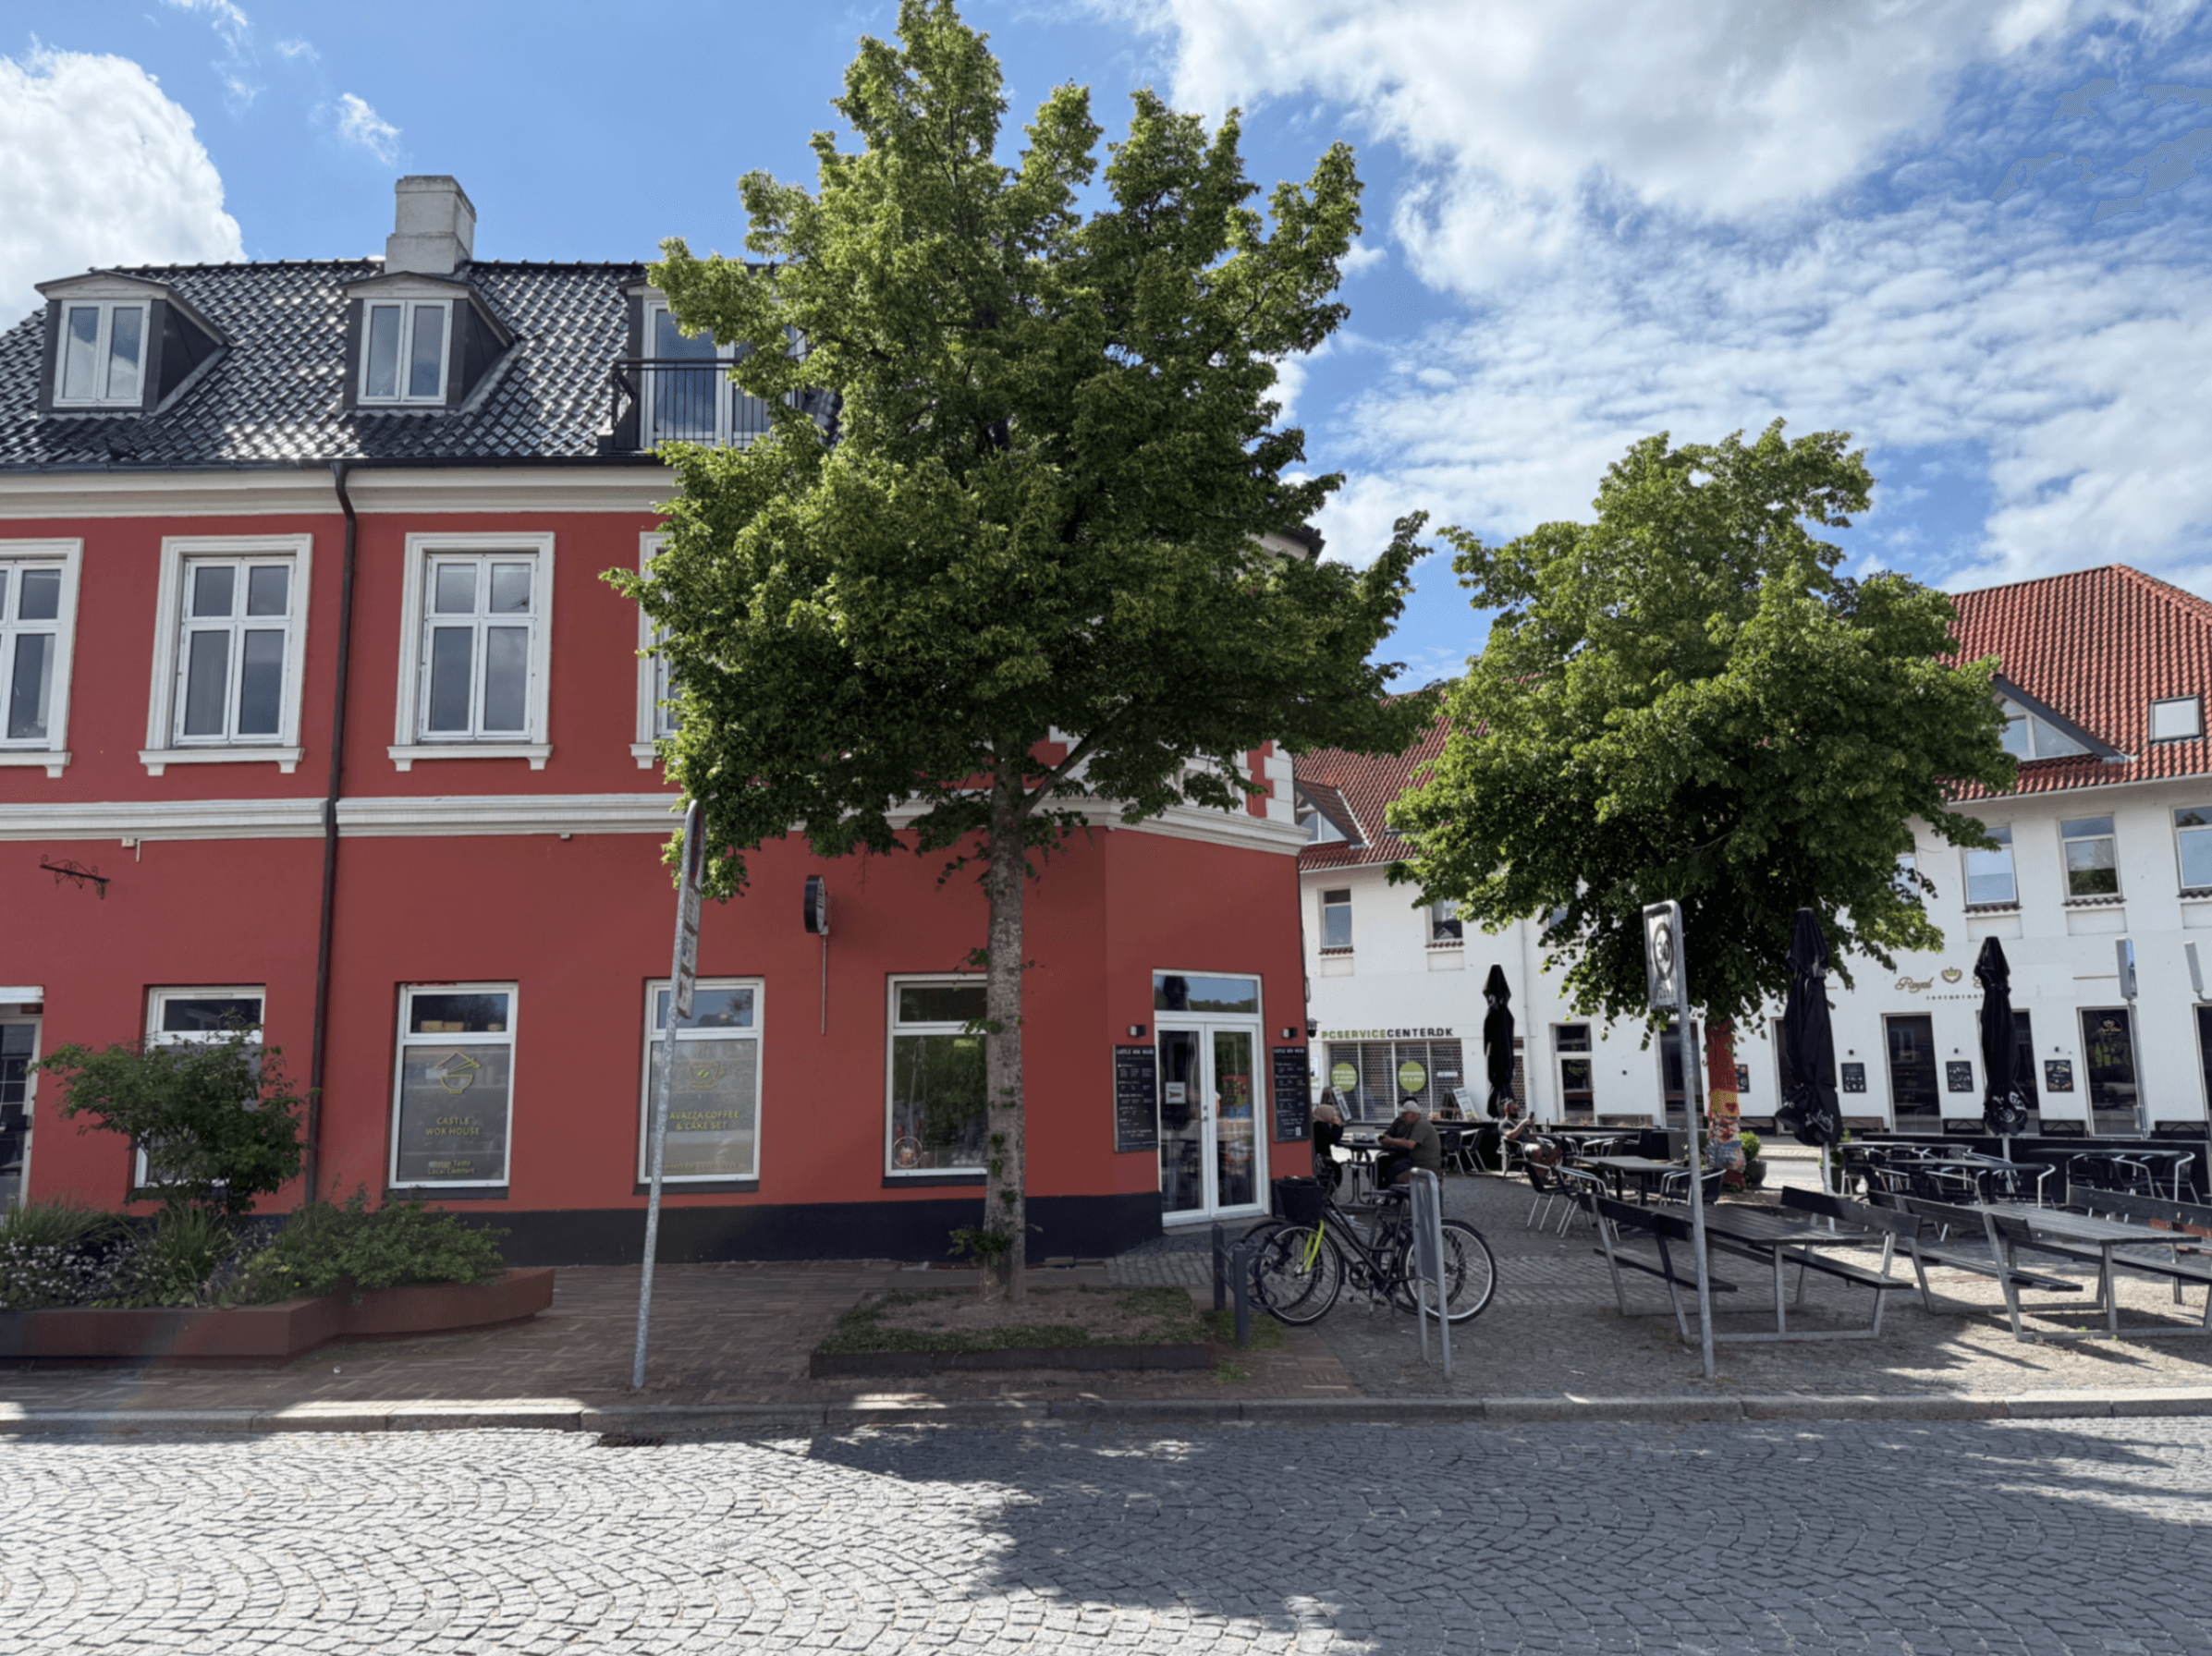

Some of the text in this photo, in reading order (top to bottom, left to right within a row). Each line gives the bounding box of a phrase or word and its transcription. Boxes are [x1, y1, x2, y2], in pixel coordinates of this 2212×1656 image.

[1656, 940, 1670, 962] 30
[1895, 976, 1934, 993] Royal
[705, 1110, 739, 1119] COFFEE
[436, 1116, 470, 1125] CASTLE
[448, 1126, 480, 1135] HOUSE
[676, 1121, 728, 1131] & CAKE SET
